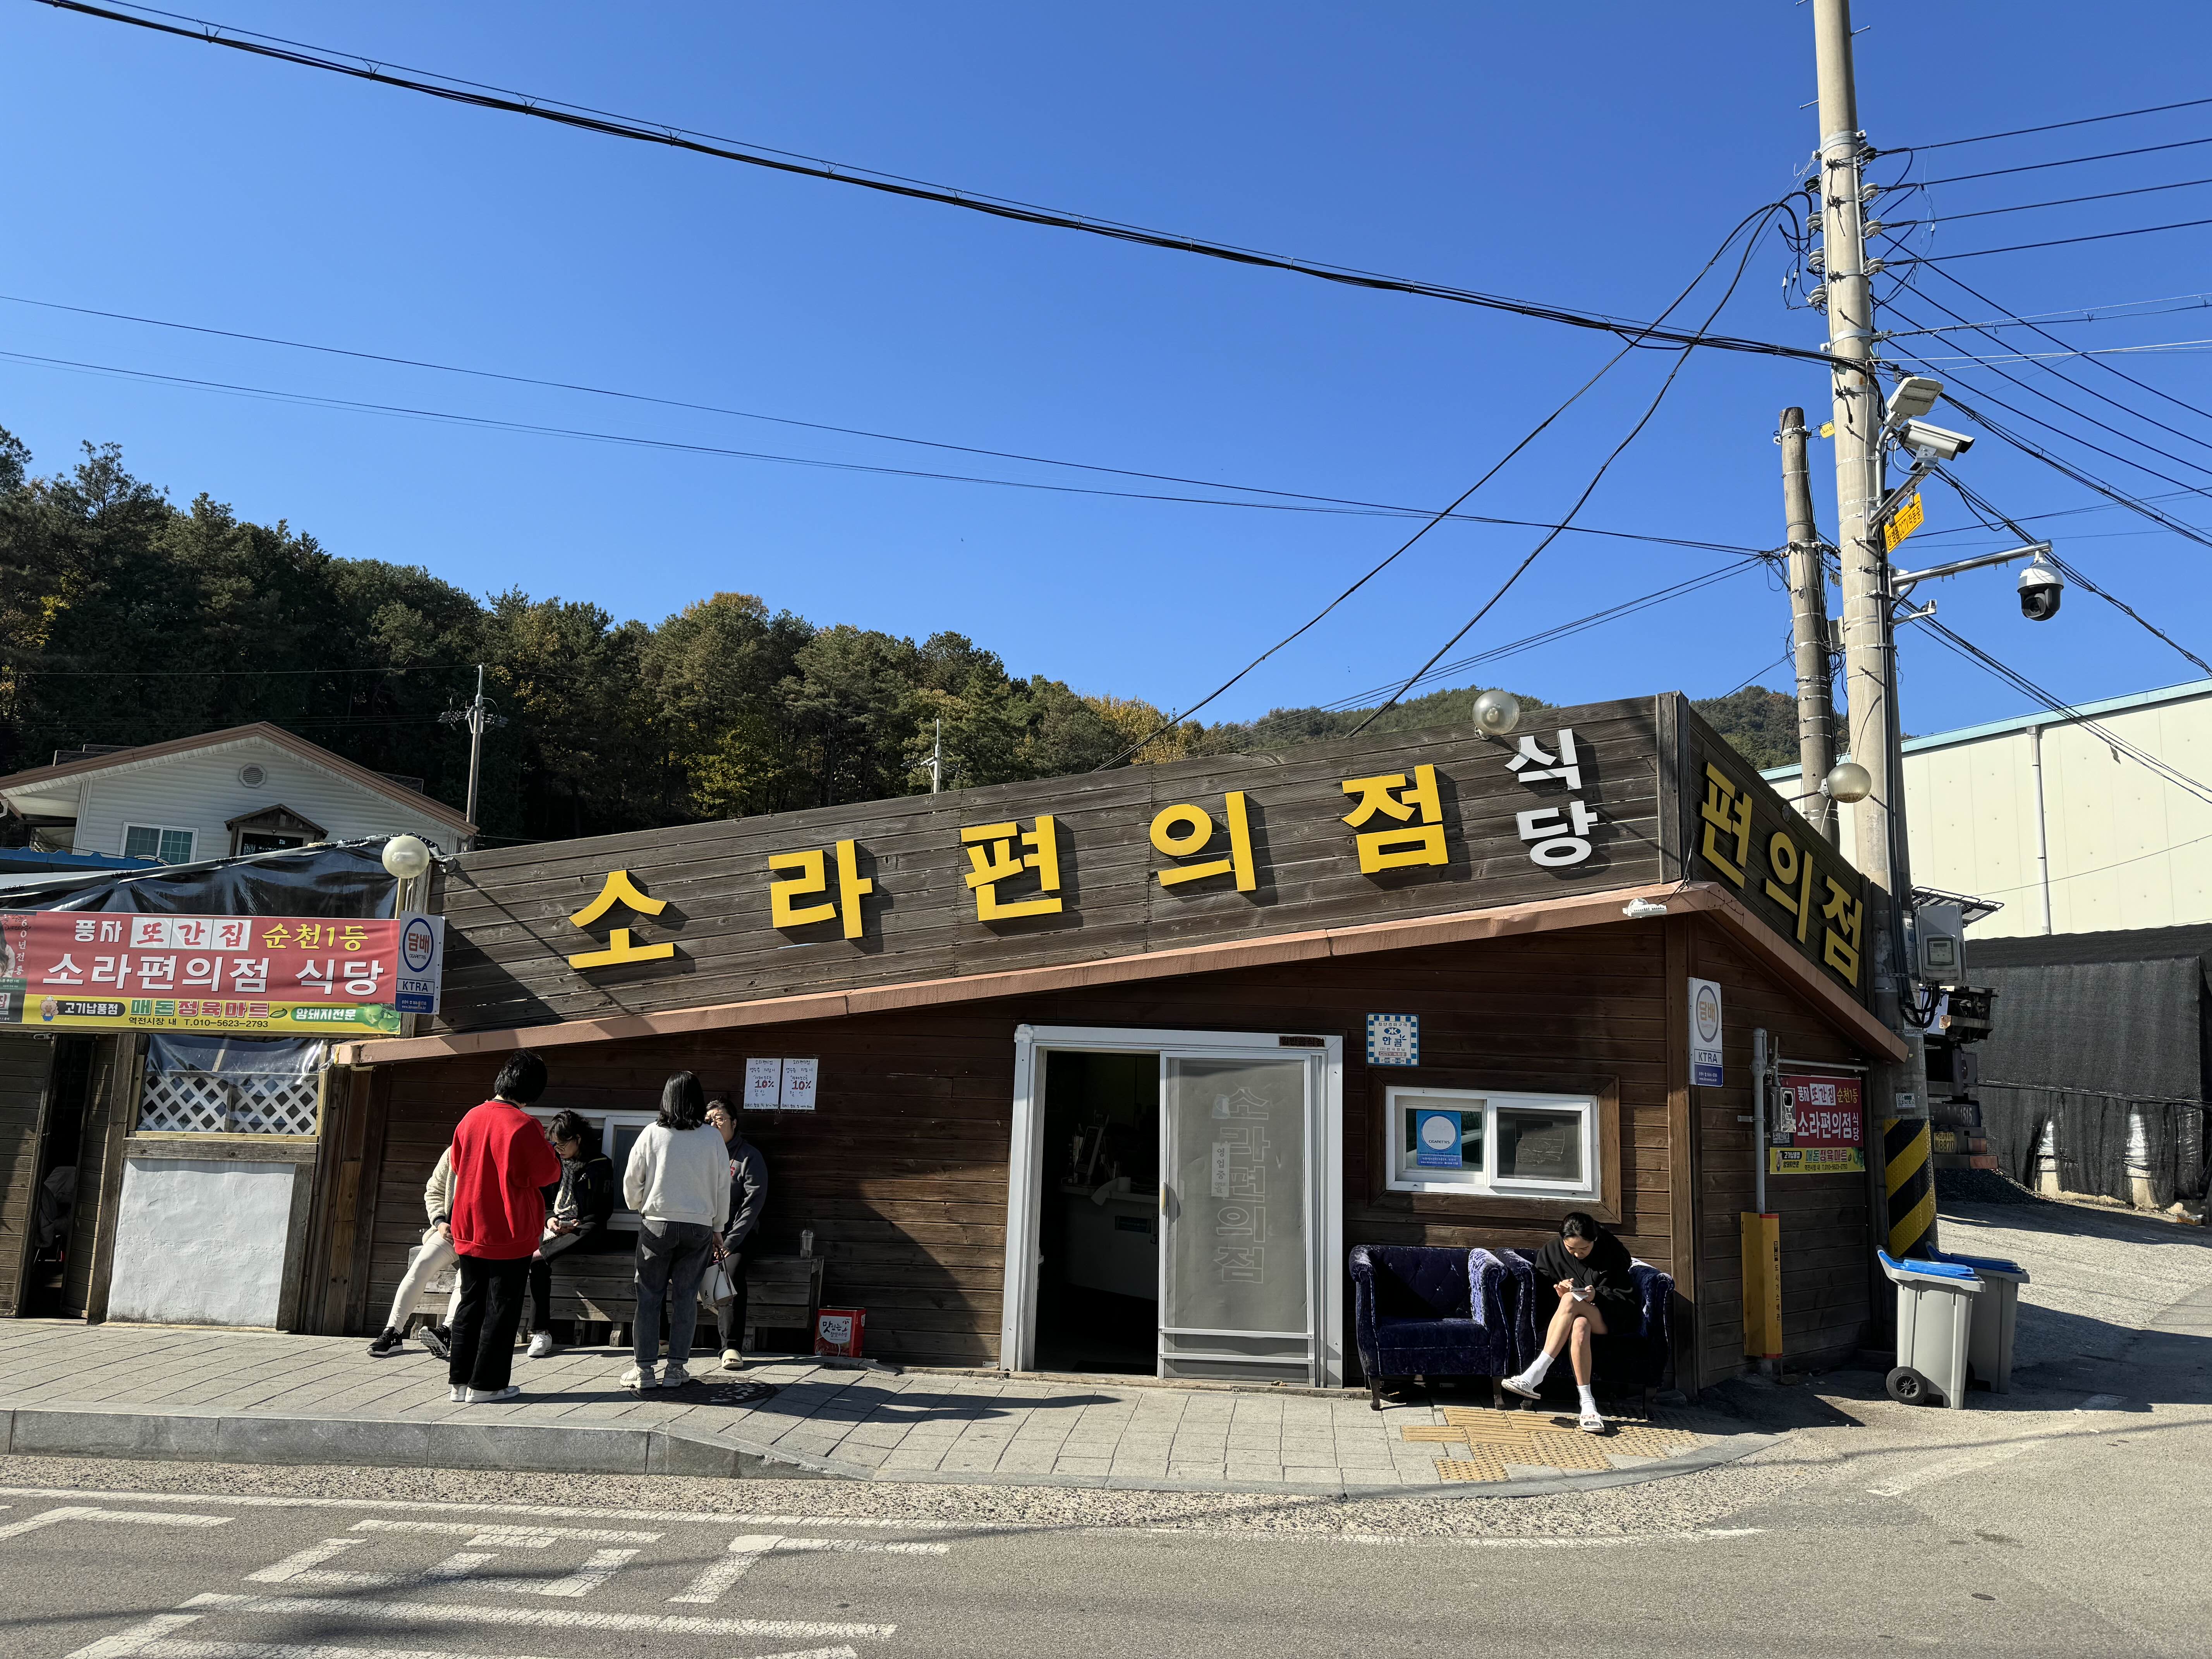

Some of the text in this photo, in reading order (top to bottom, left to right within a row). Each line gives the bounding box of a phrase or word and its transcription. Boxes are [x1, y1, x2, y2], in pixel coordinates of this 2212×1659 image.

[1899, 517, 1909, 536] CCTV
[1908, 505, 1921, 526] 작동중
[1506, 728, 1599, 868] 식당
[569, 764, 1449, 968] 소라편의점
[1702, 762, 1863, 988] 편의점
[75, 919, 369, 951] 풍자 또간집 순천1등
[408, 932, 430, 954] 담배
[43, 953, 384, 996] 소라편의점 식당
[402, 981, 428, 992] KTRA
[65, 1002, 118, 1015] 고기납품점
[130, 999, 269, 1018] 매돈정육마트
[296, 1008, 356, 1021] 암돼지전문
[1699, 1001, 1716, 1023] 담배
[129, 1017, 165, 1025] 역전시장
[184, 1018, 268, 1027] T.010-5623-2793
[1698, 1051, 1718, 1063] KTRA
[754, 1079, 774, 1089] 10%
[792, 1080, 812, 1091] 10%
[1797, 1085, 1859, 1104] 풍자 또간집 순천1등
[1797, 1111, 1852, 1139] 소라편의점
[1853, 1112, 1859, 1141] 식당
[1939, 1140, 1954, 1151] 8870
[823, 1320, 842, 1333] 맛있는
